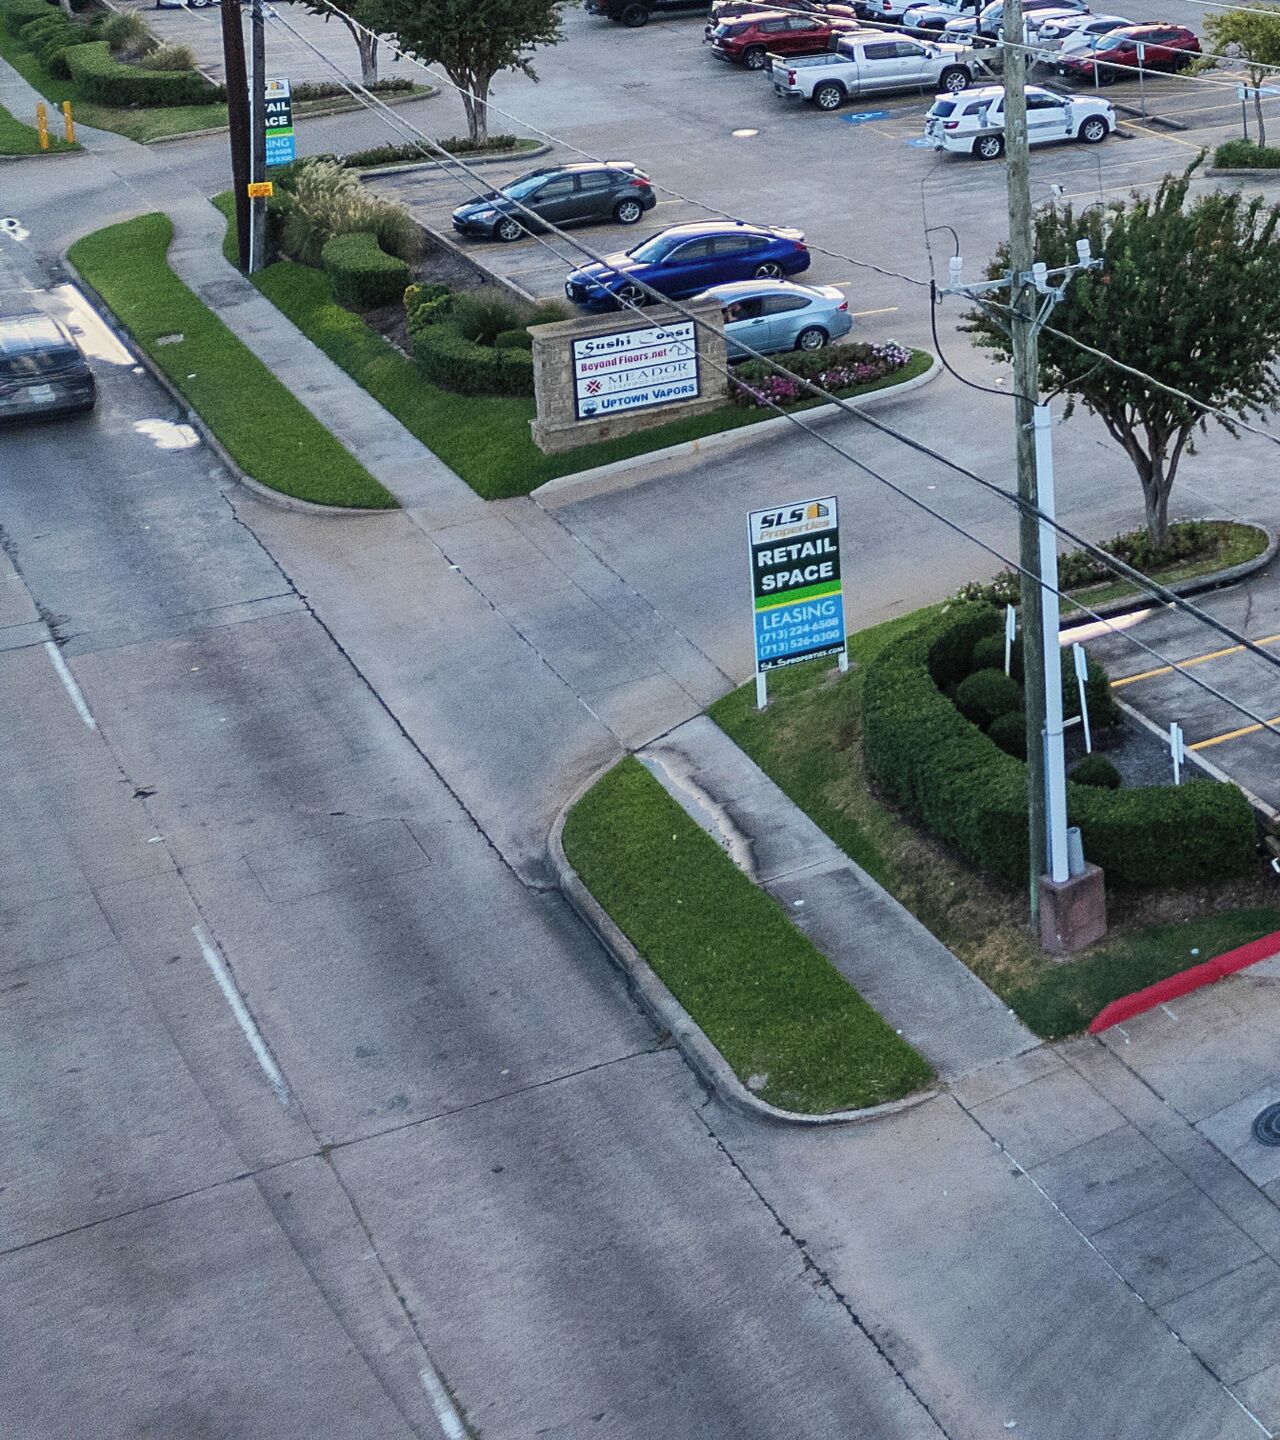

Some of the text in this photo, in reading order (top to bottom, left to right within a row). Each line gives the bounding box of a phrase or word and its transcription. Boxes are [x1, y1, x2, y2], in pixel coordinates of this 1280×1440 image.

[265, 102, 290, 112] AIL
[577, 335, 631, 356] Sushi
[608, 362, 688, 385] MEADOR
[601, 384, 695, 409] UPTOWN VAPORS
[760, 507, 804, 529] SLS
[759, 519, 830, 541] Properties
[757, 537, 837, 567] RETAIL
[761, 561, 833, 591] SPACE
[763, 600, 836, 630] LEASING
[760, 629, 788, 645] (713)
[760, 642, 789, 657] (713)
